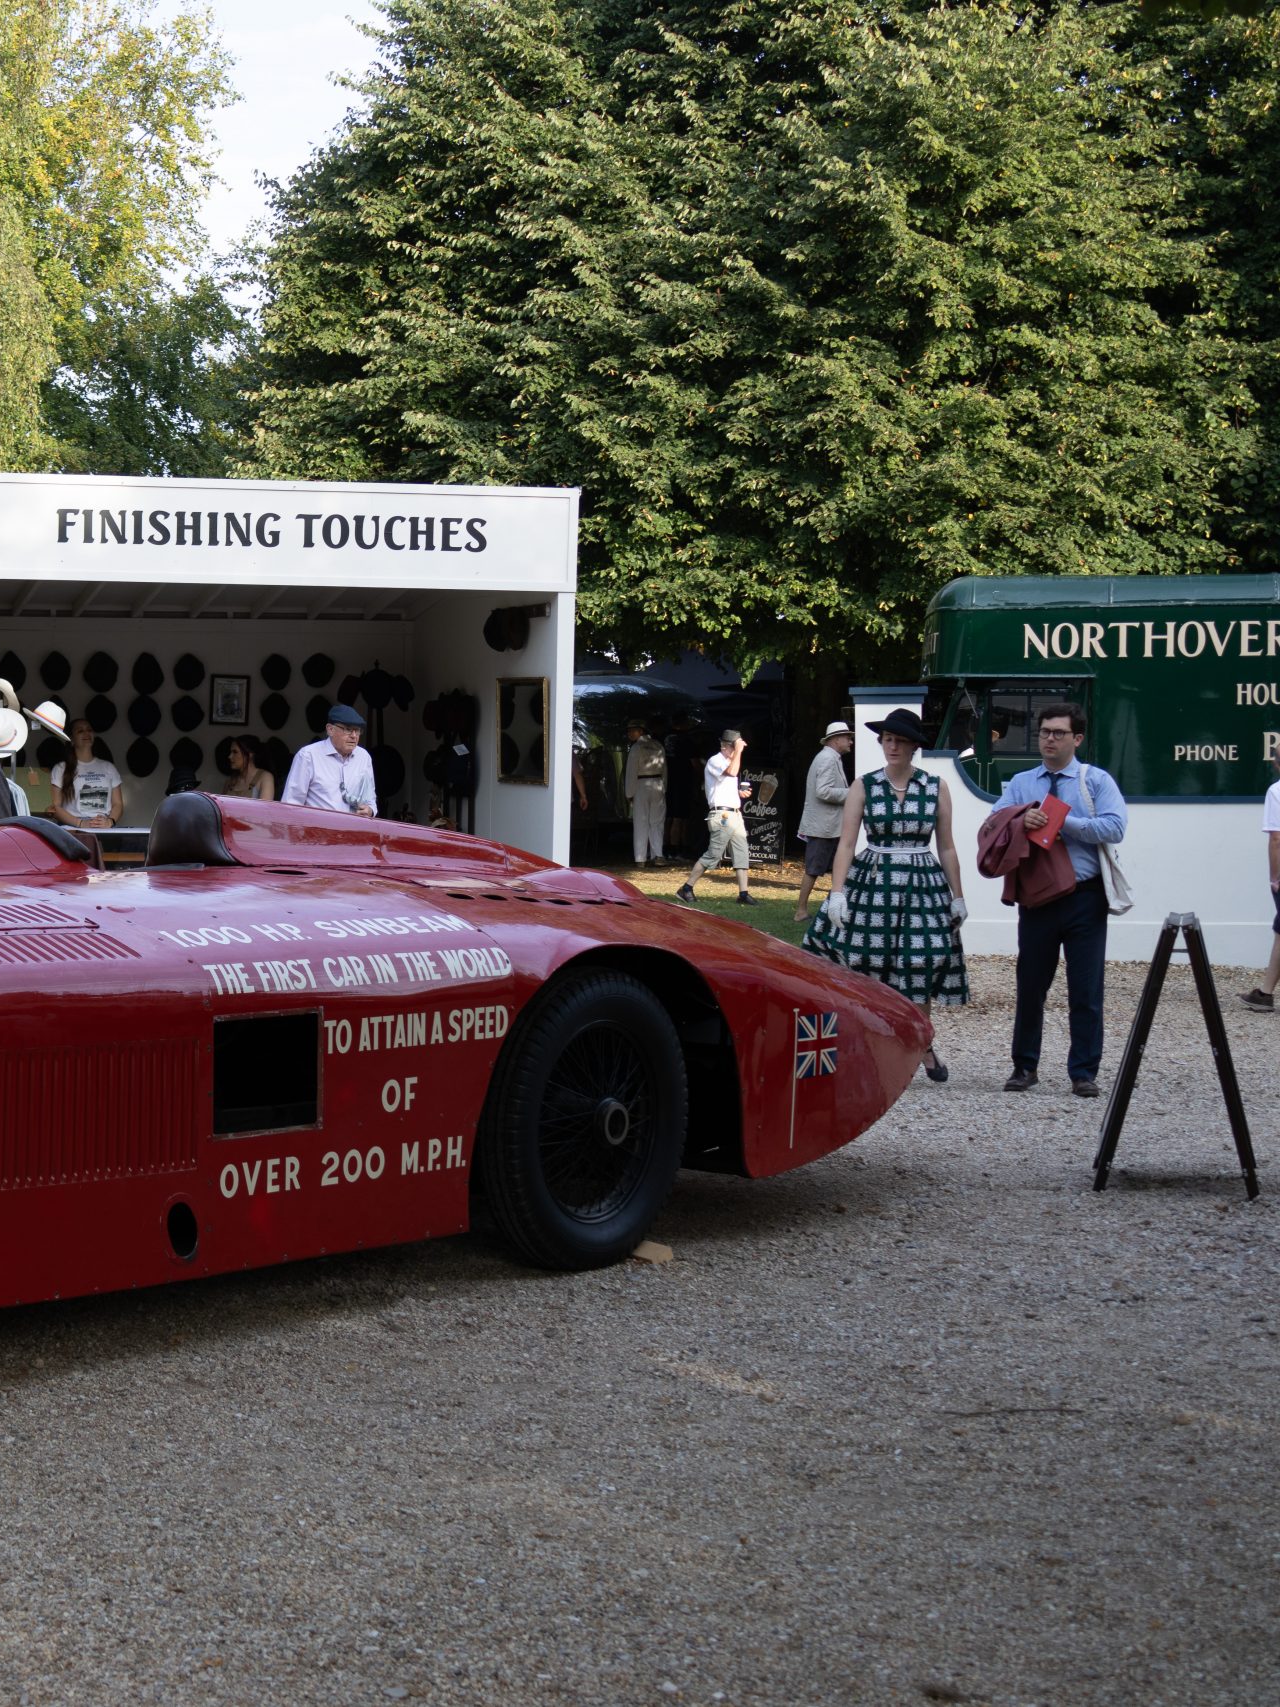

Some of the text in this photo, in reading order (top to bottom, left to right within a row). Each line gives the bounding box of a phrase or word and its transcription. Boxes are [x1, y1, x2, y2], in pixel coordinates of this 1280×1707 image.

[56, 508, 488, 553] FINISHING TOUCHES
[1174, 745, 1239, 761] PHONE
[743, 769, 763, 782] Iced
[743, 800, 777, 816] Coffee
[250, 923, 312, 942] H.P.
[314, 914, 475, 938] SUNBEAM
[202, 947, 512, 995] THE FIRST CAR IN THE WORLD
[323, 1005, 509, 1054] TO ATTAIN A SPEED
[381, 1076, 418, 1113] OF
[220, 1135, 466, 1199] OVER 200 M.P.H.
